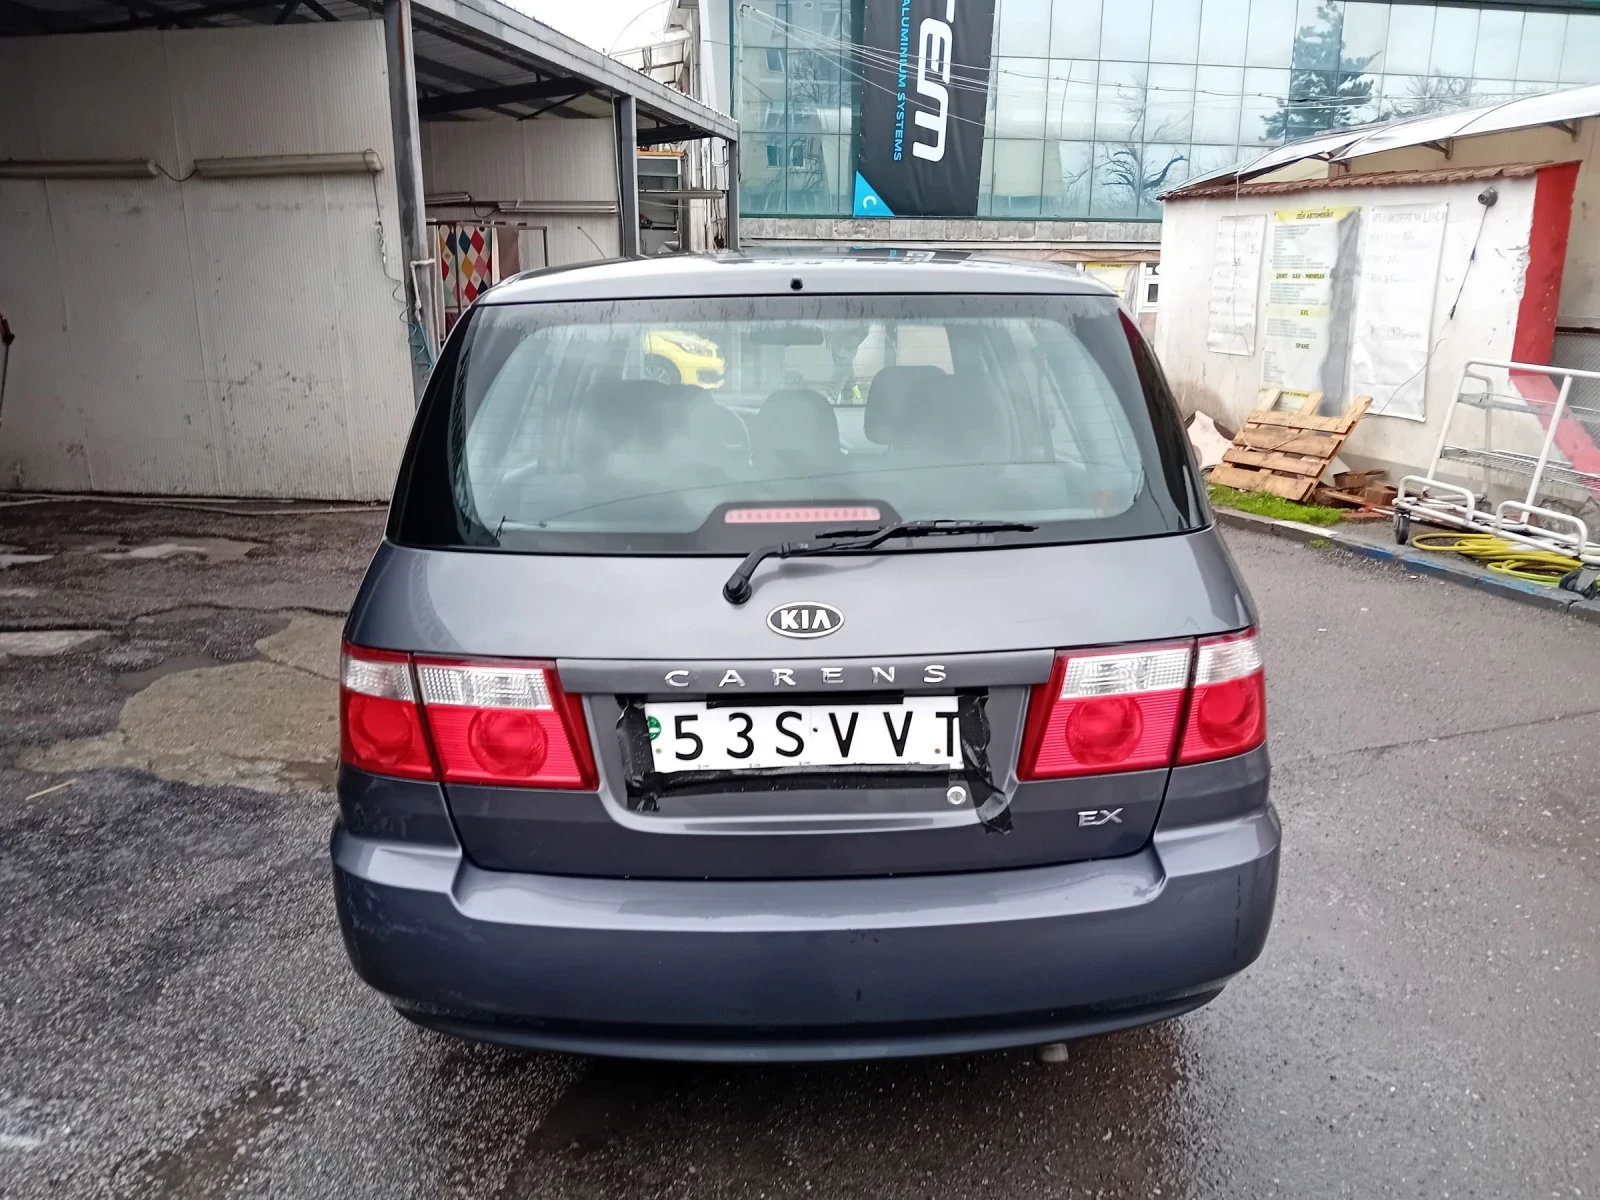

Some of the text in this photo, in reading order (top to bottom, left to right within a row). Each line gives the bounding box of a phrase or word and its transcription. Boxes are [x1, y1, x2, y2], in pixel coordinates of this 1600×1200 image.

[894, 0, 911, 162] ALUMINIUM SYSTEMS
[780, 609, 831, 630] KIA
[664, 665, 947, 687] CARENS
[1077, 807, 1124, 827] EX
